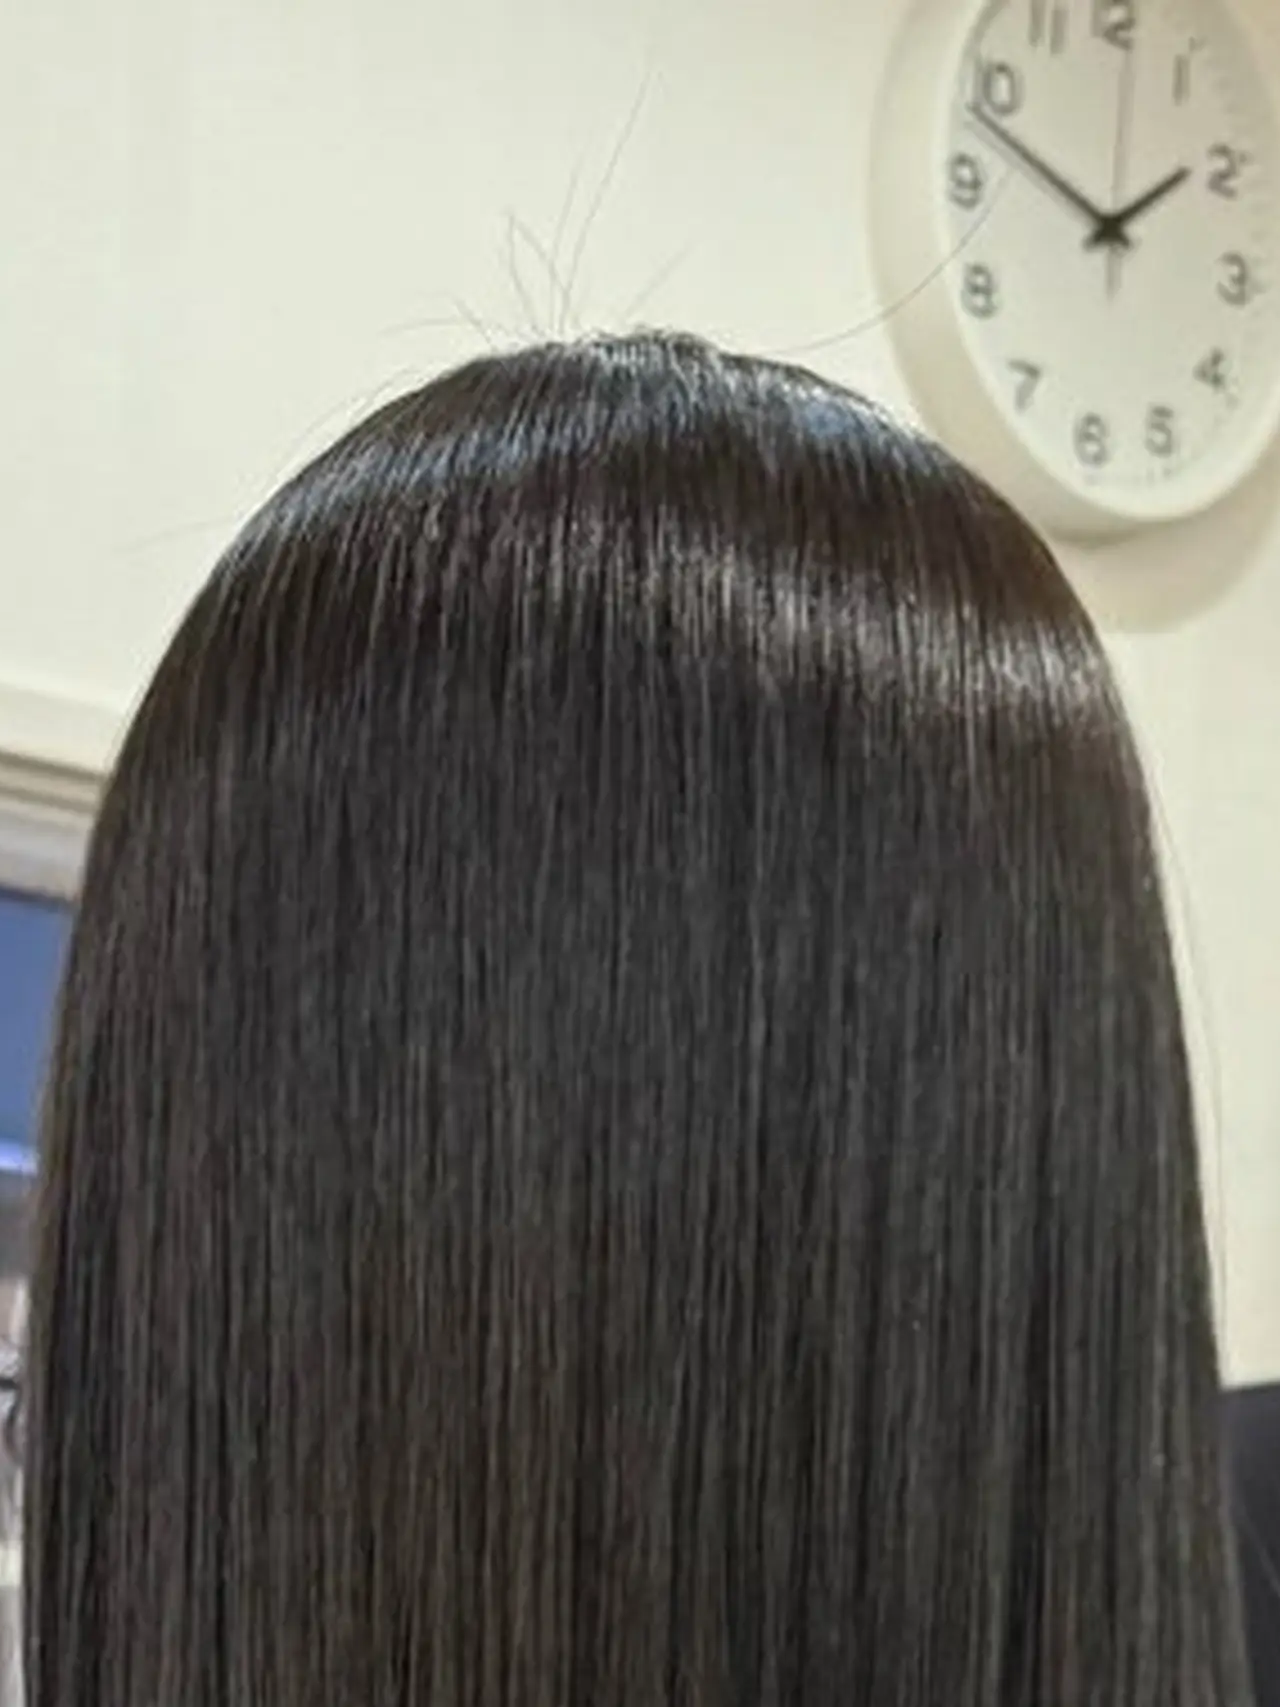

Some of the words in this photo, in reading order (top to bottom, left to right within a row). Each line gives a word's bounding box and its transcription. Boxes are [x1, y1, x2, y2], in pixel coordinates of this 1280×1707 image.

[946, 153, 982, 209] 9
[1207, 145, 1238, 198] 2
[961, 263, 998, 319] 8
[1217, 252, 1250, 306] 3
[1007, 358, 1041, 410] 7
[1192, 348, 1225, 392] 4
[1073, 412, 1108, 468] 6
[1144, 406, 1175, 458] 5
